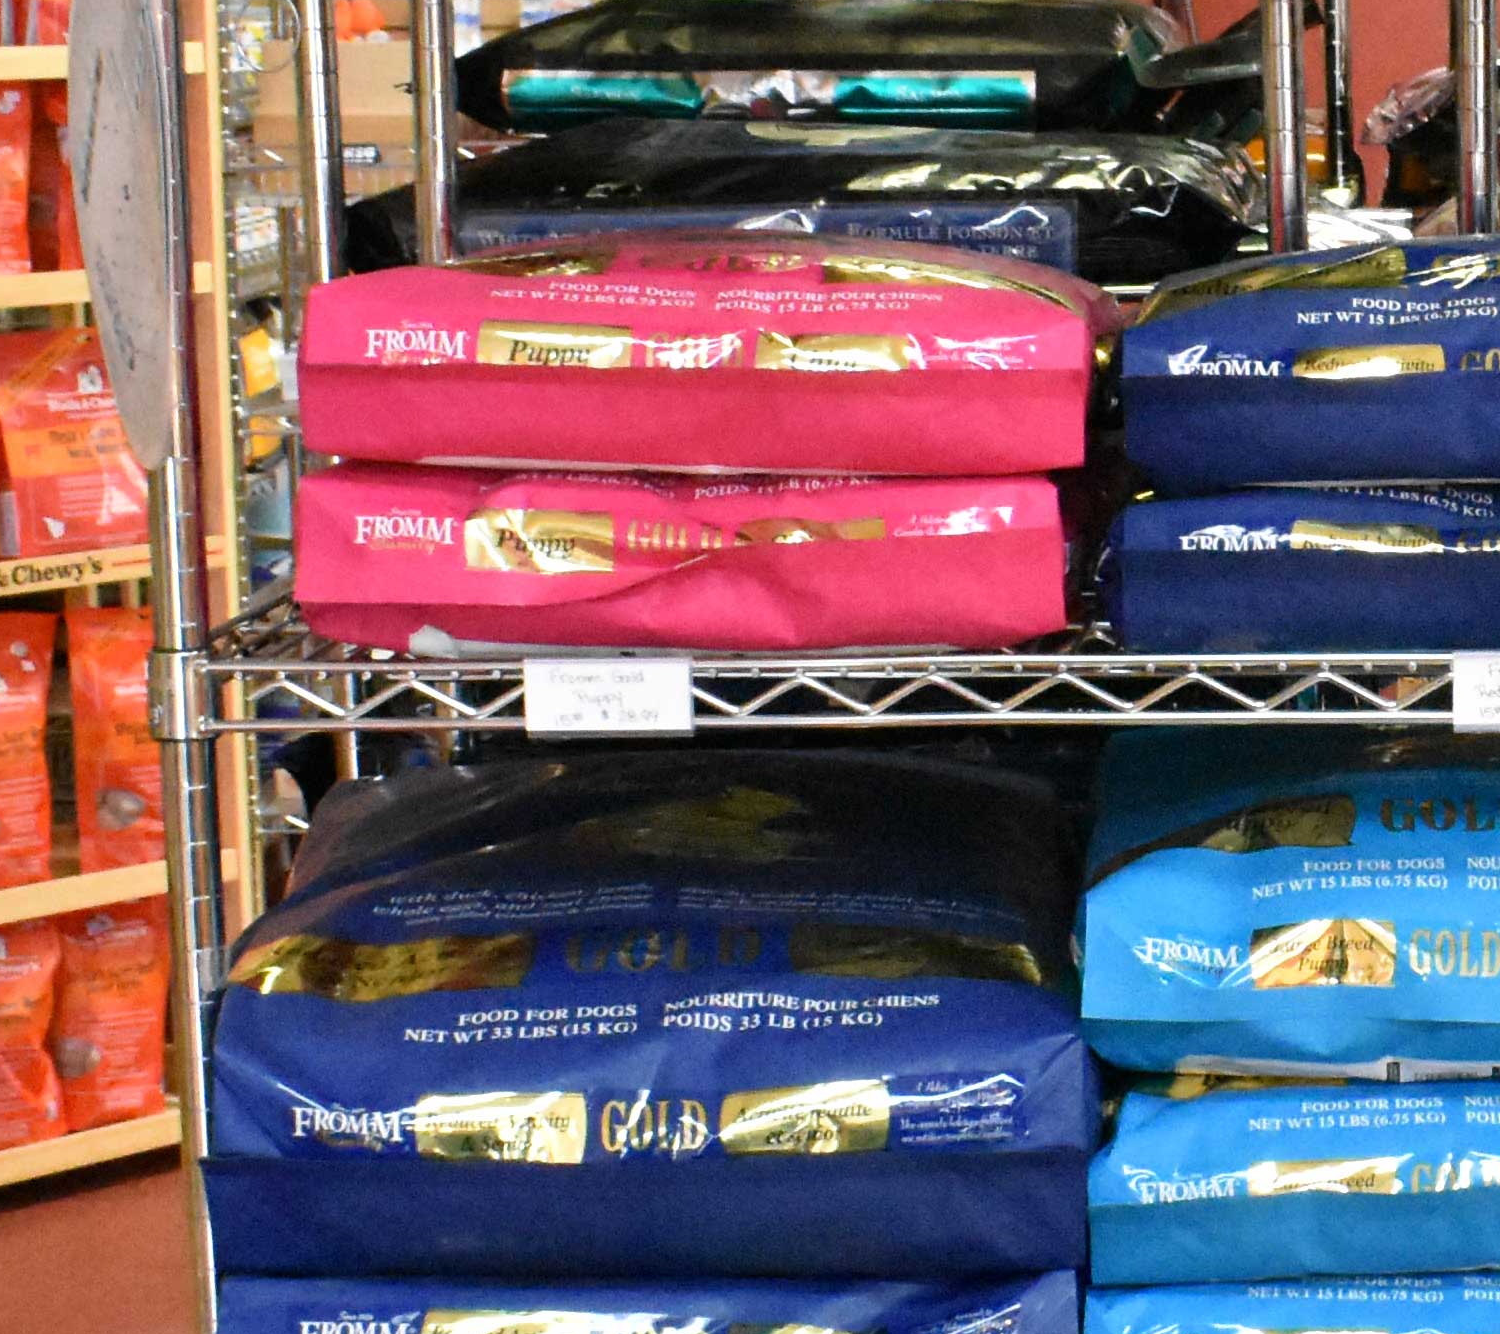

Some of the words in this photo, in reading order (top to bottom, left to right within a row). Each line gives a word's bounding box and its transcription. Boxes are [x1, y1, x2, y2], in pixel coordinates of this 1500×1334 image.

[364, 329, 465, 360] FROMM
[356, 515, 454, 546] FROMM
[498, 528, 576, 559] Puppy
[13, 555, 104, 588] Chewy's
[403, 1027, 450, 1044] NET
[453, 1028, 488, 1044] WT
[490, 1026, 514, 1041] 33
[518, 1022, 558, 1039] LBS
[661, 1010, 733, 1033] POIDS
[739, 1014, 765, 1031] 33
[768, 1013, 796, 1030] LB
